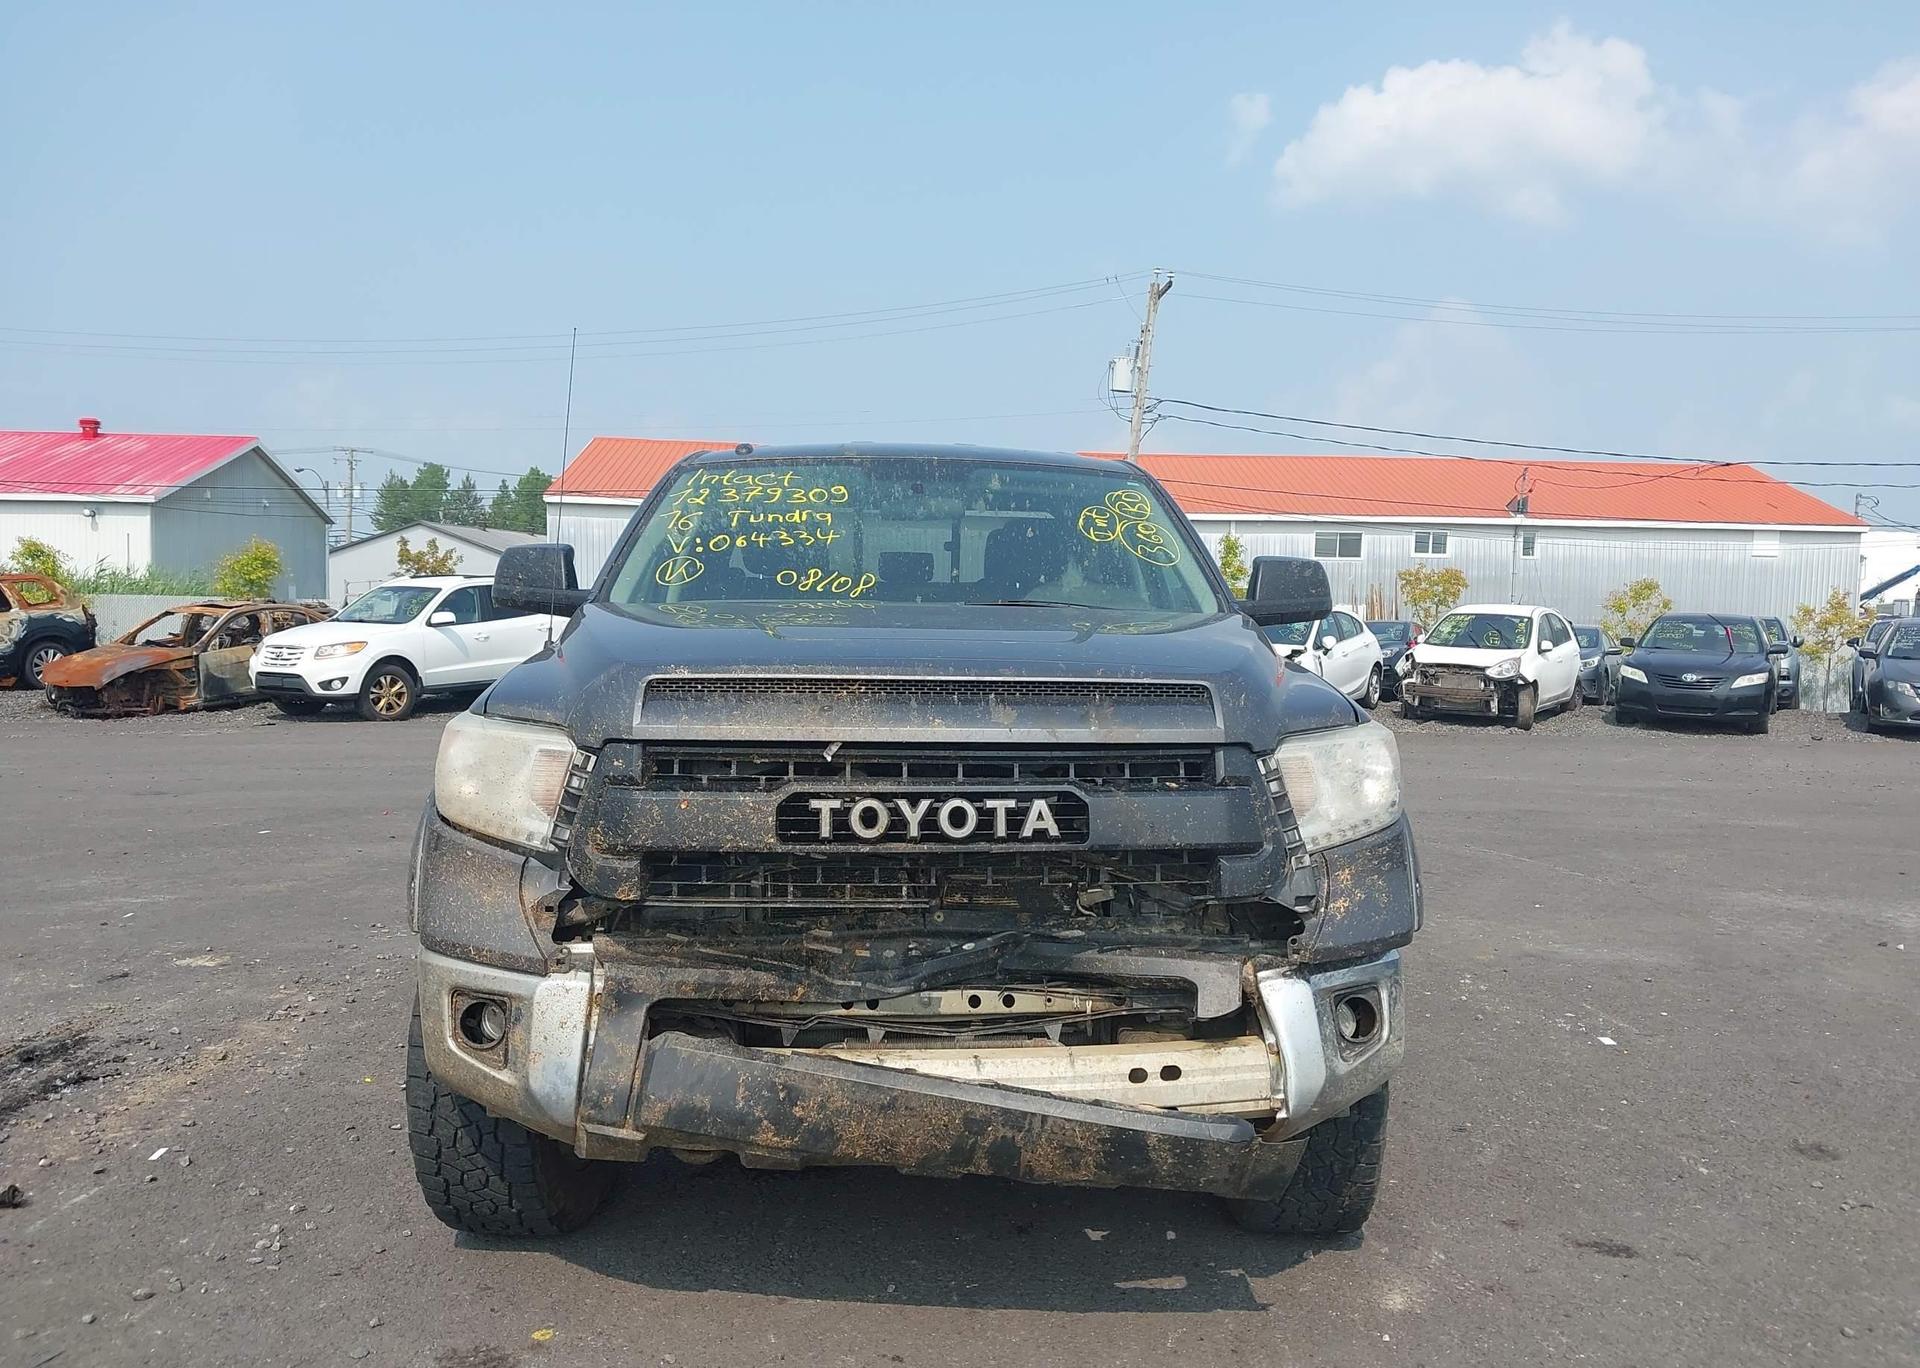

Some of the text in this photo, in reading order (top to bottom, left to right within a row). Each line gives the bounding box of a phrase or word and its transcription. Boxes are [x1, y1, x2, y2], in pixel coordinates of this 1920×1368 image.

[687, 468, 801, 486] Intact
[660, 509, 833, 531] 16 Tundra
[809, 797, 1062, 840] TOYOTA
